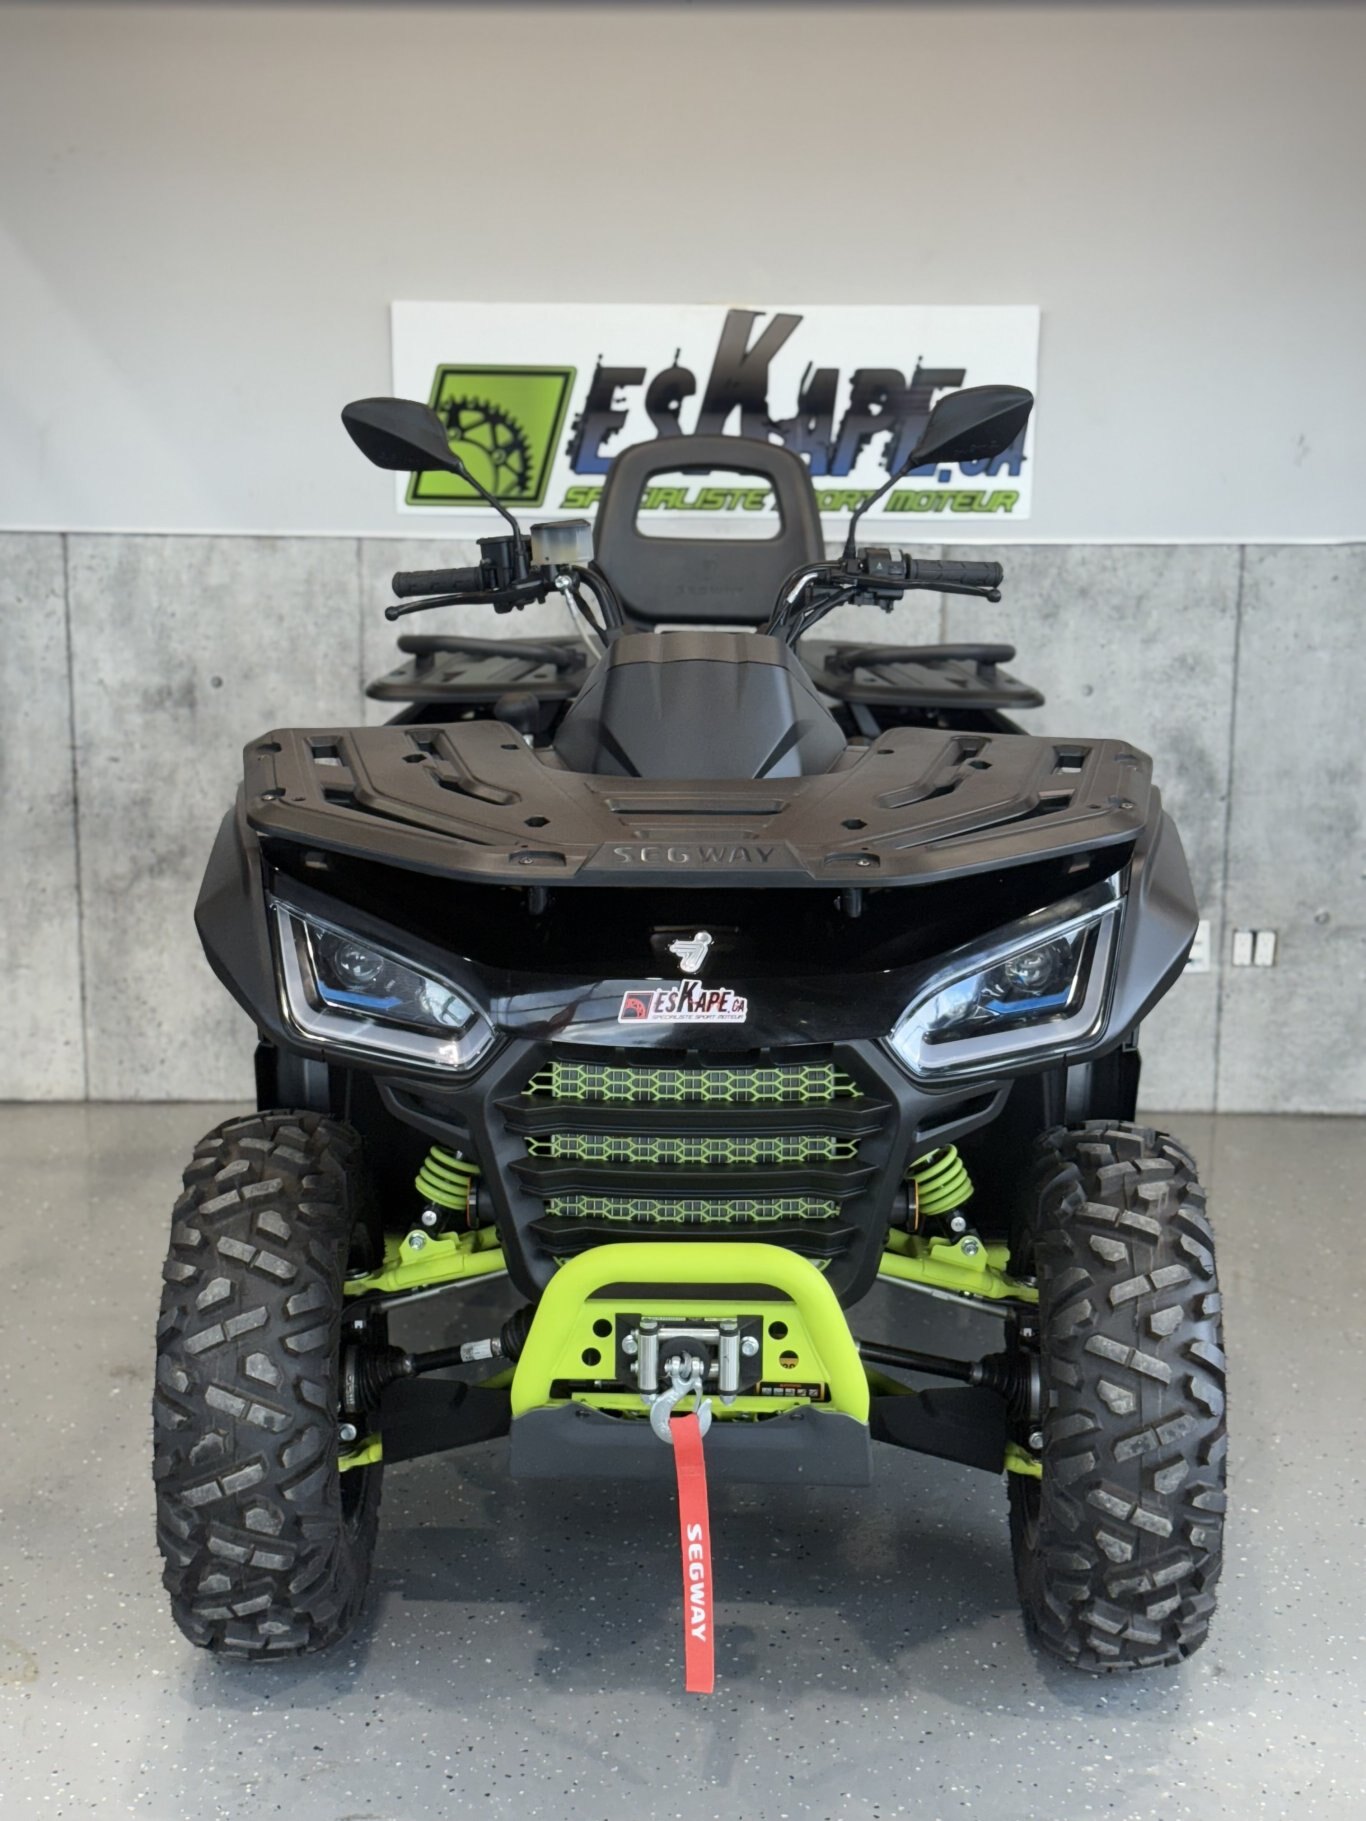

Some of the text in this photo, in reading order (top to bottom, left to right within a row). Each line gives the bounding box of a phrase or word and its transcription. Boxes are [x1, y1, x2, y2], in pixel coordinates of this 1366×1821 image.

[559, 486, 1019, 513] SPIALISTE ORT MOTEUR
[613, 847, 774, 864] SEGWAY
[653, 981, 745, 1014] ESKAPE.CA
[687, 1523, 706, 1643] SEGWAY
